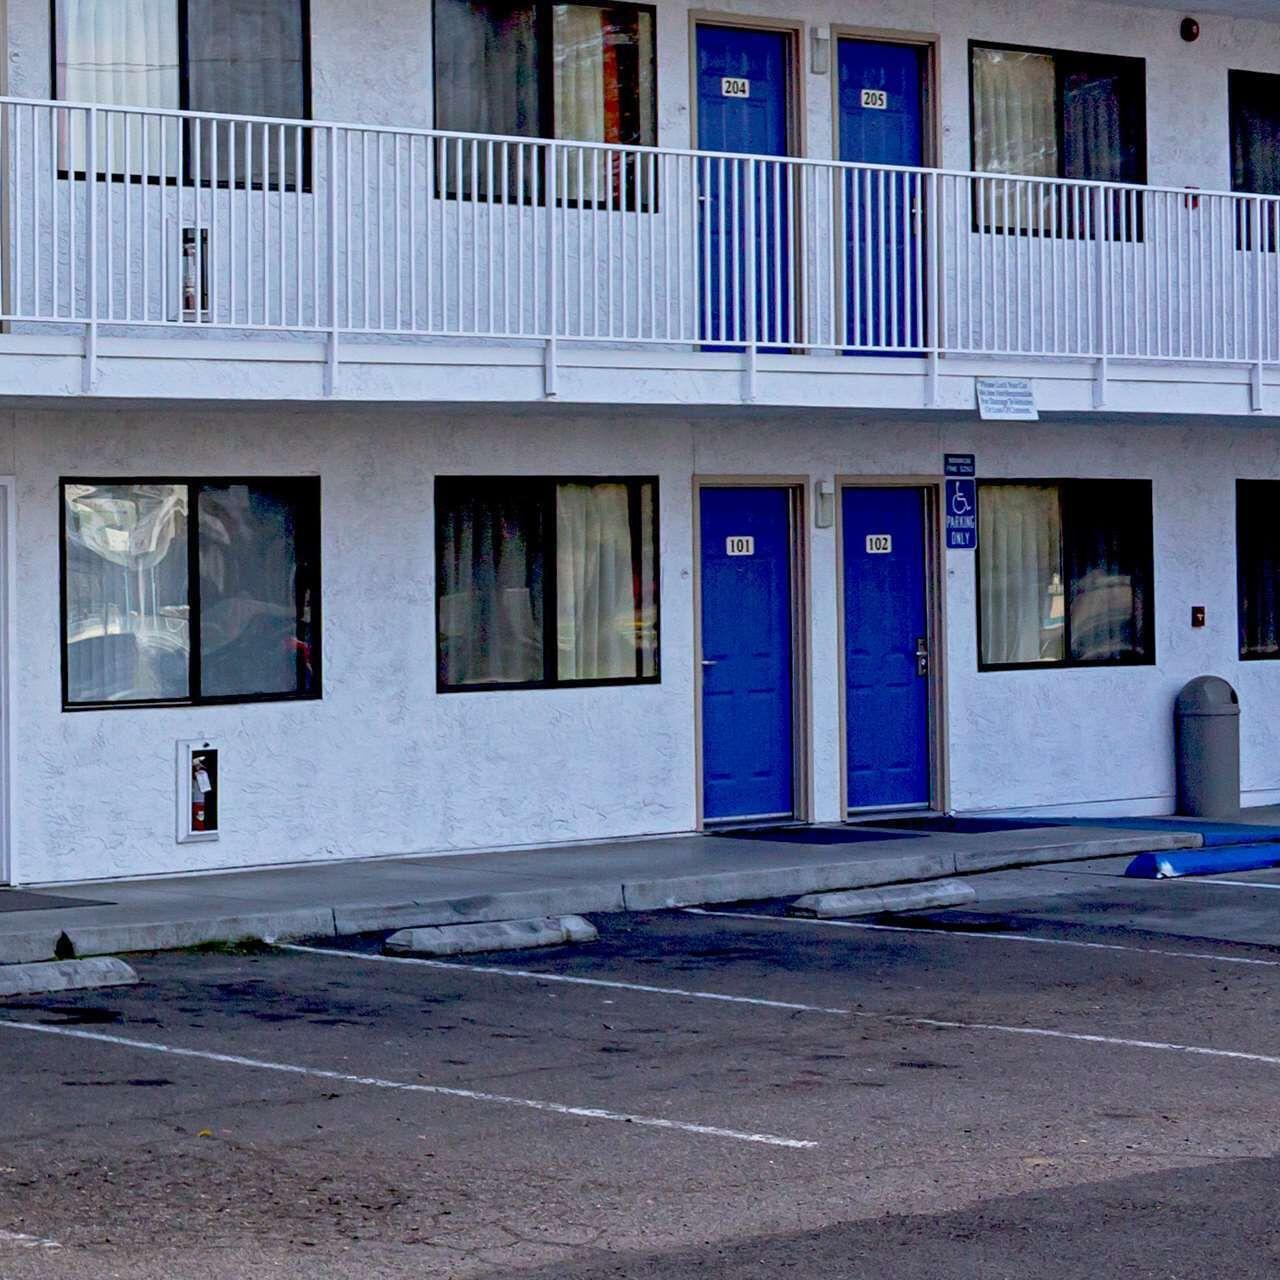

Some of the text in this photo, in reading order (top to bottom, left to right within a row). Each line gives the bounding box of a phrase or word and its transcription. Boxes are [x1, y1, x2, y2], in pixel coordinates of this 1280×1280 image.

[724, 80, 747, 95] 204
[863, 92, 885, 107] 205
[946, 515, 975, 529] PARKING
[869, 537, 889, 551] 102
[951, 531, 971, 545] ONLY
[730, 539, 751, 553] 101
